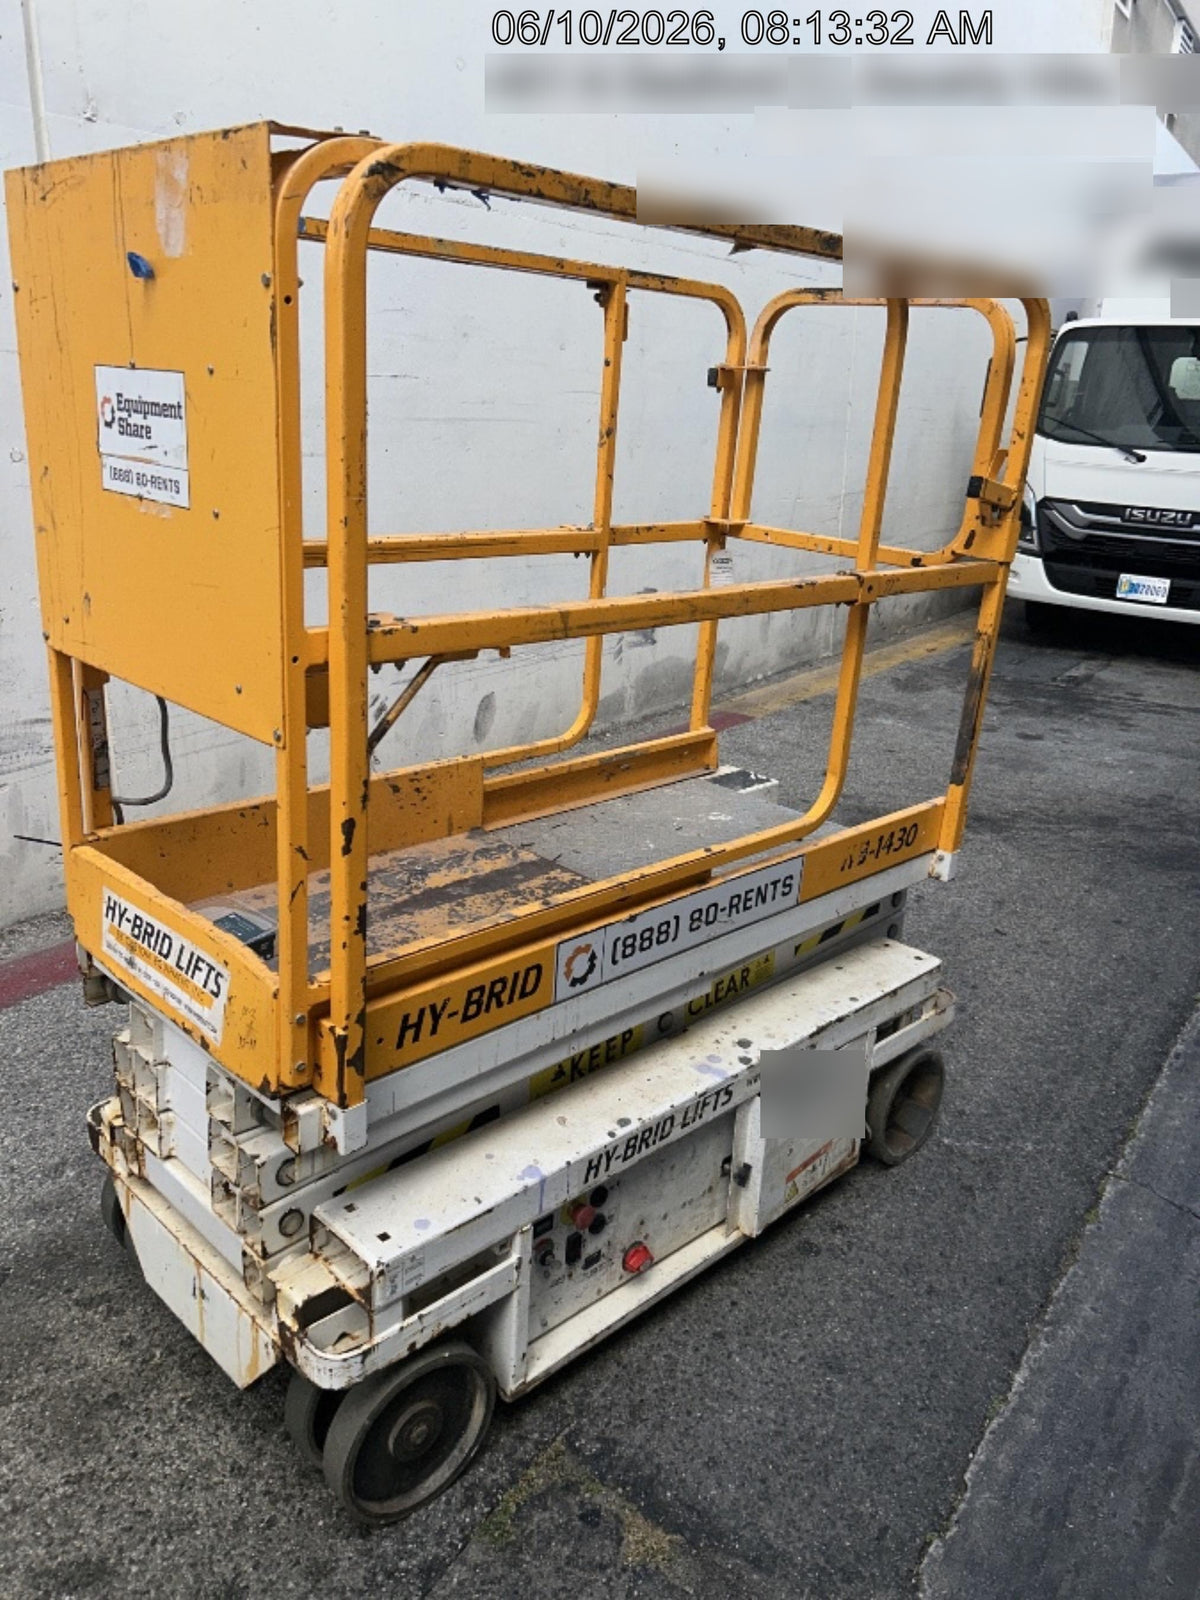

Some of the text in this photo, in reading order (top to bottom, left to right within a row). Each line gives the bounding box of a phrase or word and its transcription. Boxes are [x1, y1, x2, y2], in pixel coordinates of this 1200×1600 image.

[116, 393, 183, 420] Equipment
[118, 417, 152, 440] Share
[1124, 508, 1193, 525] ISUZU
[105, 896, 173, 964] HY-BRID
[175, 944, 225, 999] LIFTS
[611, 874, 794, 966] (888) 80-RENTS
[396, 963, 543, 1050] HY-BRID
[569, 965, 750, 1084] KEEP CLEAR
[583, 1082, 735, 1184] HY-BRID LIFTS
